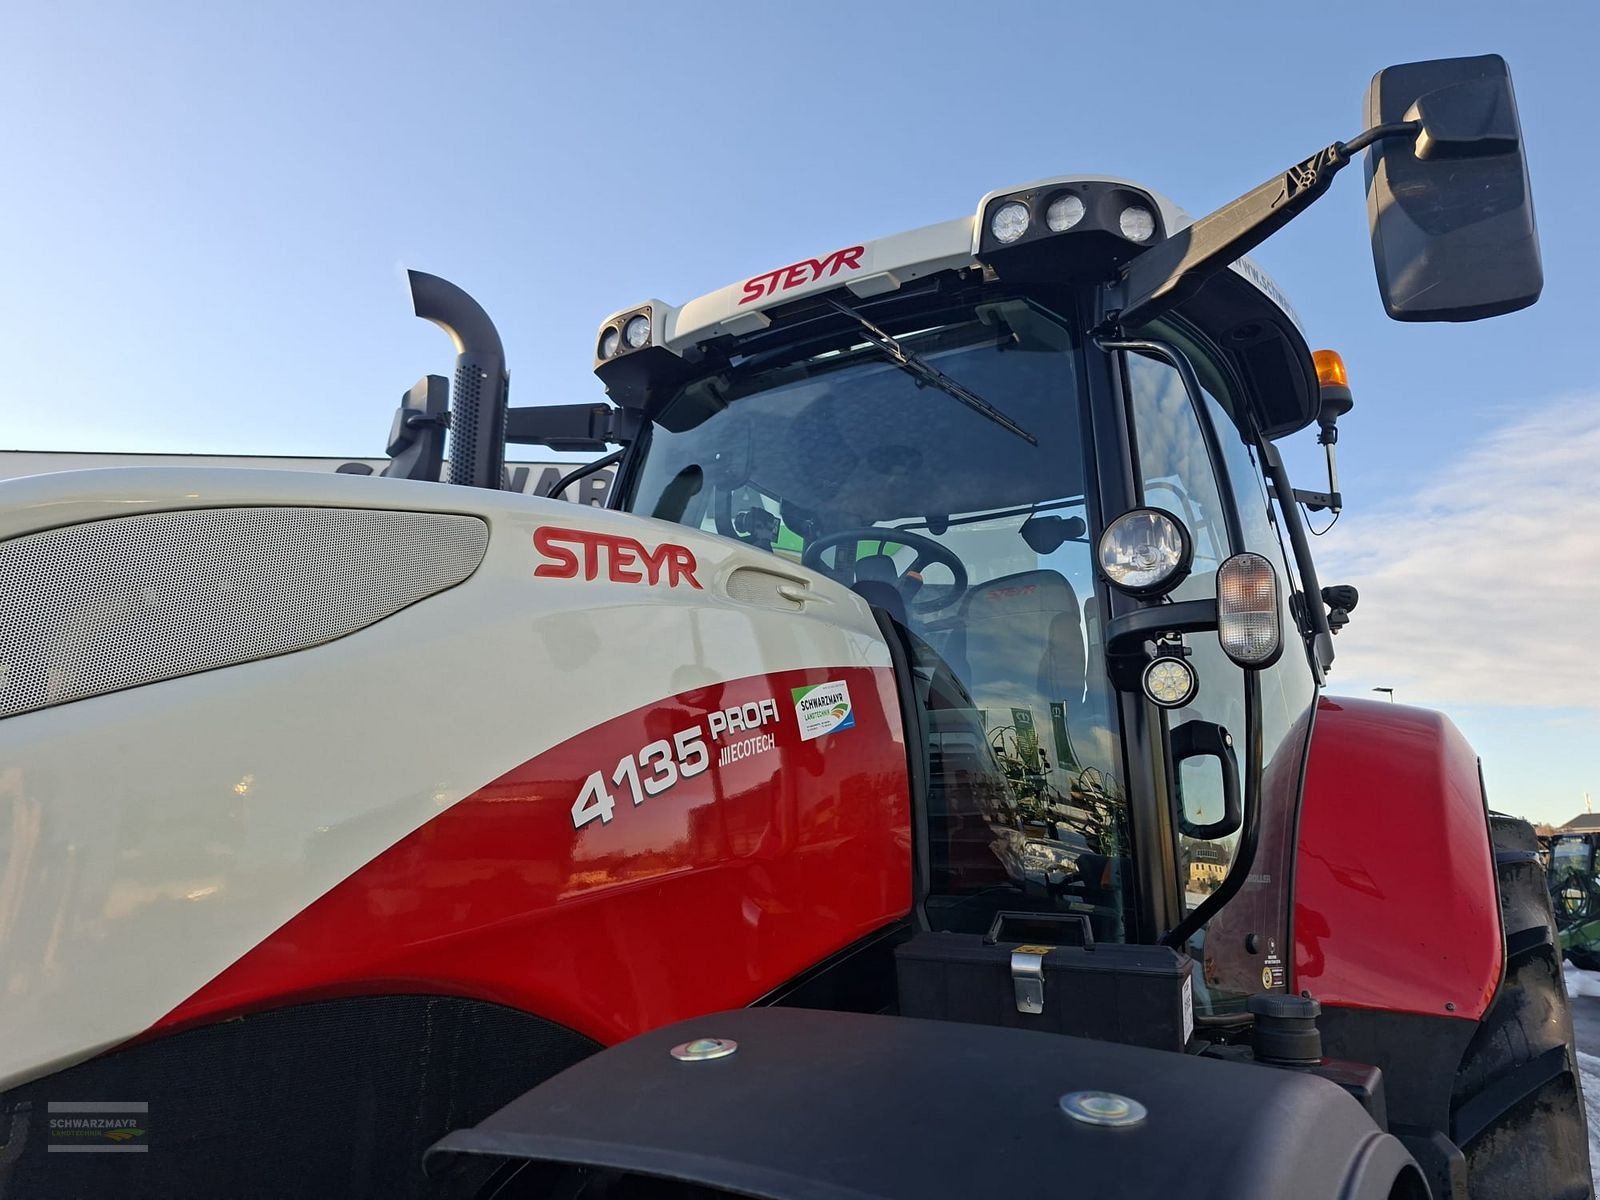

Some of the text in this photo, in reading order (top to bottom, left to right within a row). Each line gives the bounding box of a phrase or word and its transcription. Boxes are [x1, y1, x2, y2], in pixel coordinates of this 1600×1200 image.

[738, 245, 865, 305] STEYR
[532, 526, 704, 590] STEYR
[800, 692, 844, 712] SCHWARZMAYR
[570, 698, 780, 829] 4135 PROFI
